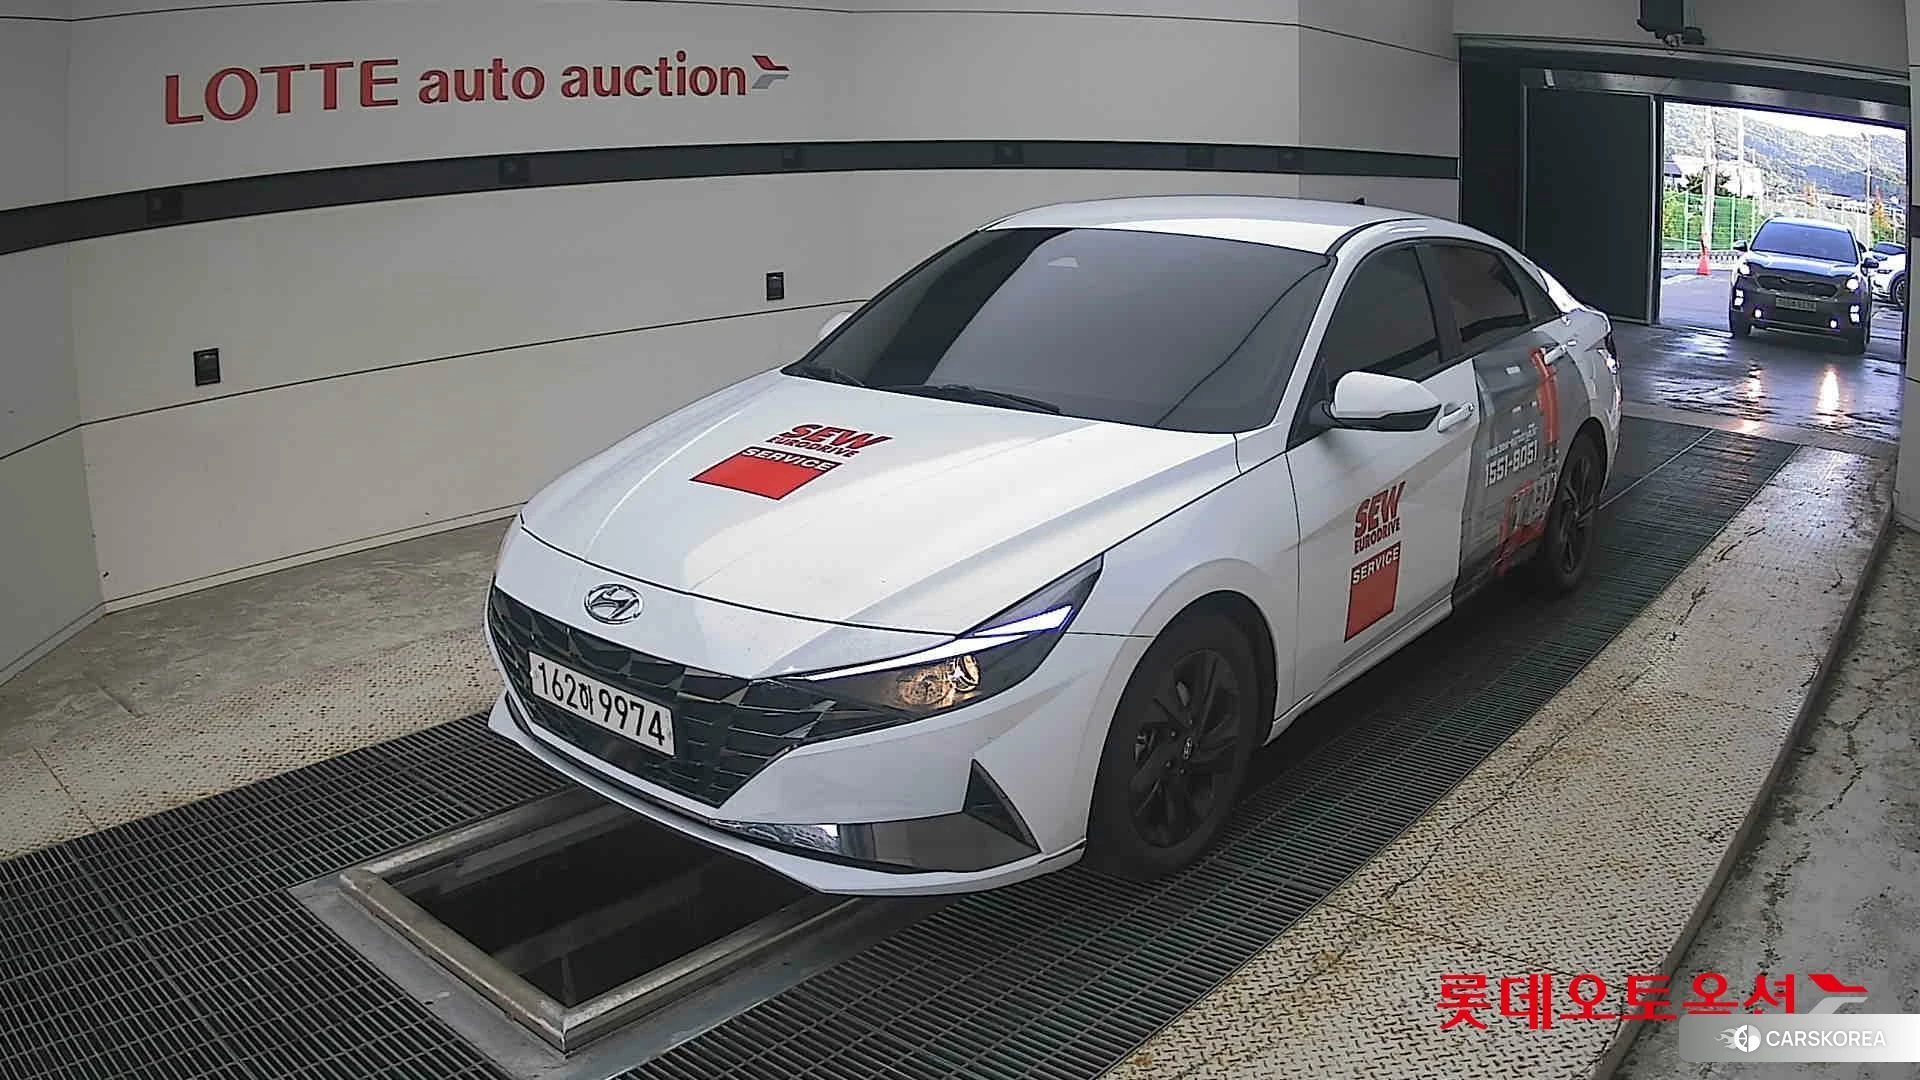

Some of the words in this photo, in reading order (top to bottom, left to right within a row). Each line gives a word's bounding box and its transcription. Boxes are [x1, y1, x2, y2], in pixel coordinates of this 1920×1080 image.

[165, 58, 399, 126] LOTTE
[418, 57, 545, 104] auto
[560, 50, 747, 97] auction
[765, 436, 860, 458] EURODRIVE
[778, 424, 893, 450] SEW
[741, 448, 836, 471] SERVICE
[1354, 480, 1406, 539] SEW
[1354, 518, 1400, 555] EURODRIVE
[1352, 546, 1400, 584] SERVICE
[599, 688, 665, 747] 9974
